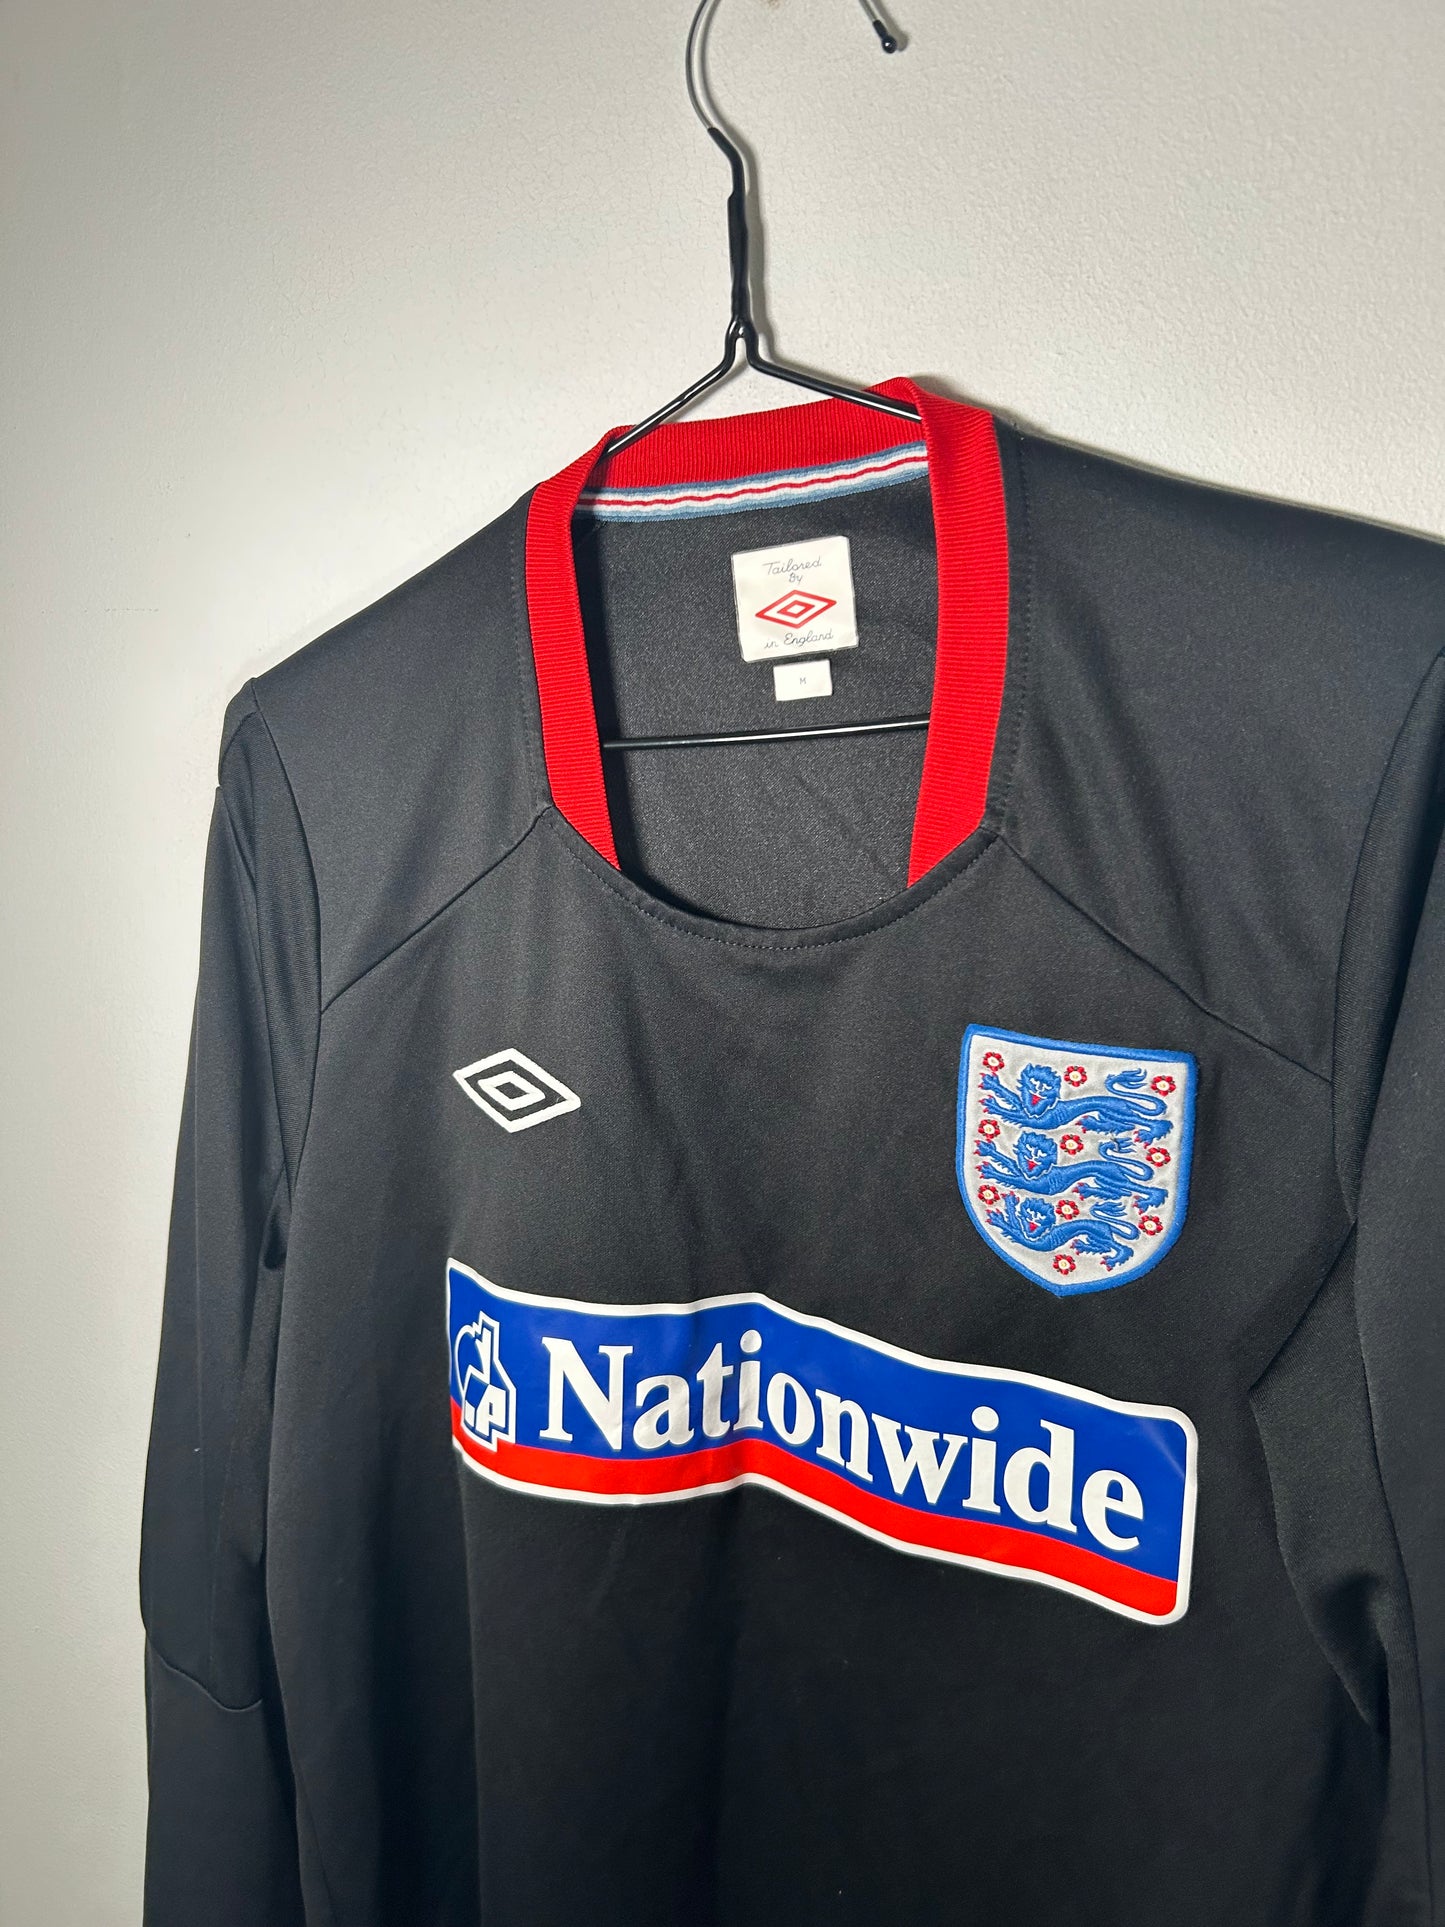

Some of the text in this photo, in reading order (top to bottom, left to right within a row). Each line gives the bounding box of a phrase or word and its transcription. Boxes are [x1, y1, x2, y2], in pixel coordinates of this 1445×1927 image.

[761, 555, 822, 576] Tailored
[764, 627, 834, 649] in England
[799, 677, 807, 685] M
[539, 1329, 1145, 1551] Nationwide
